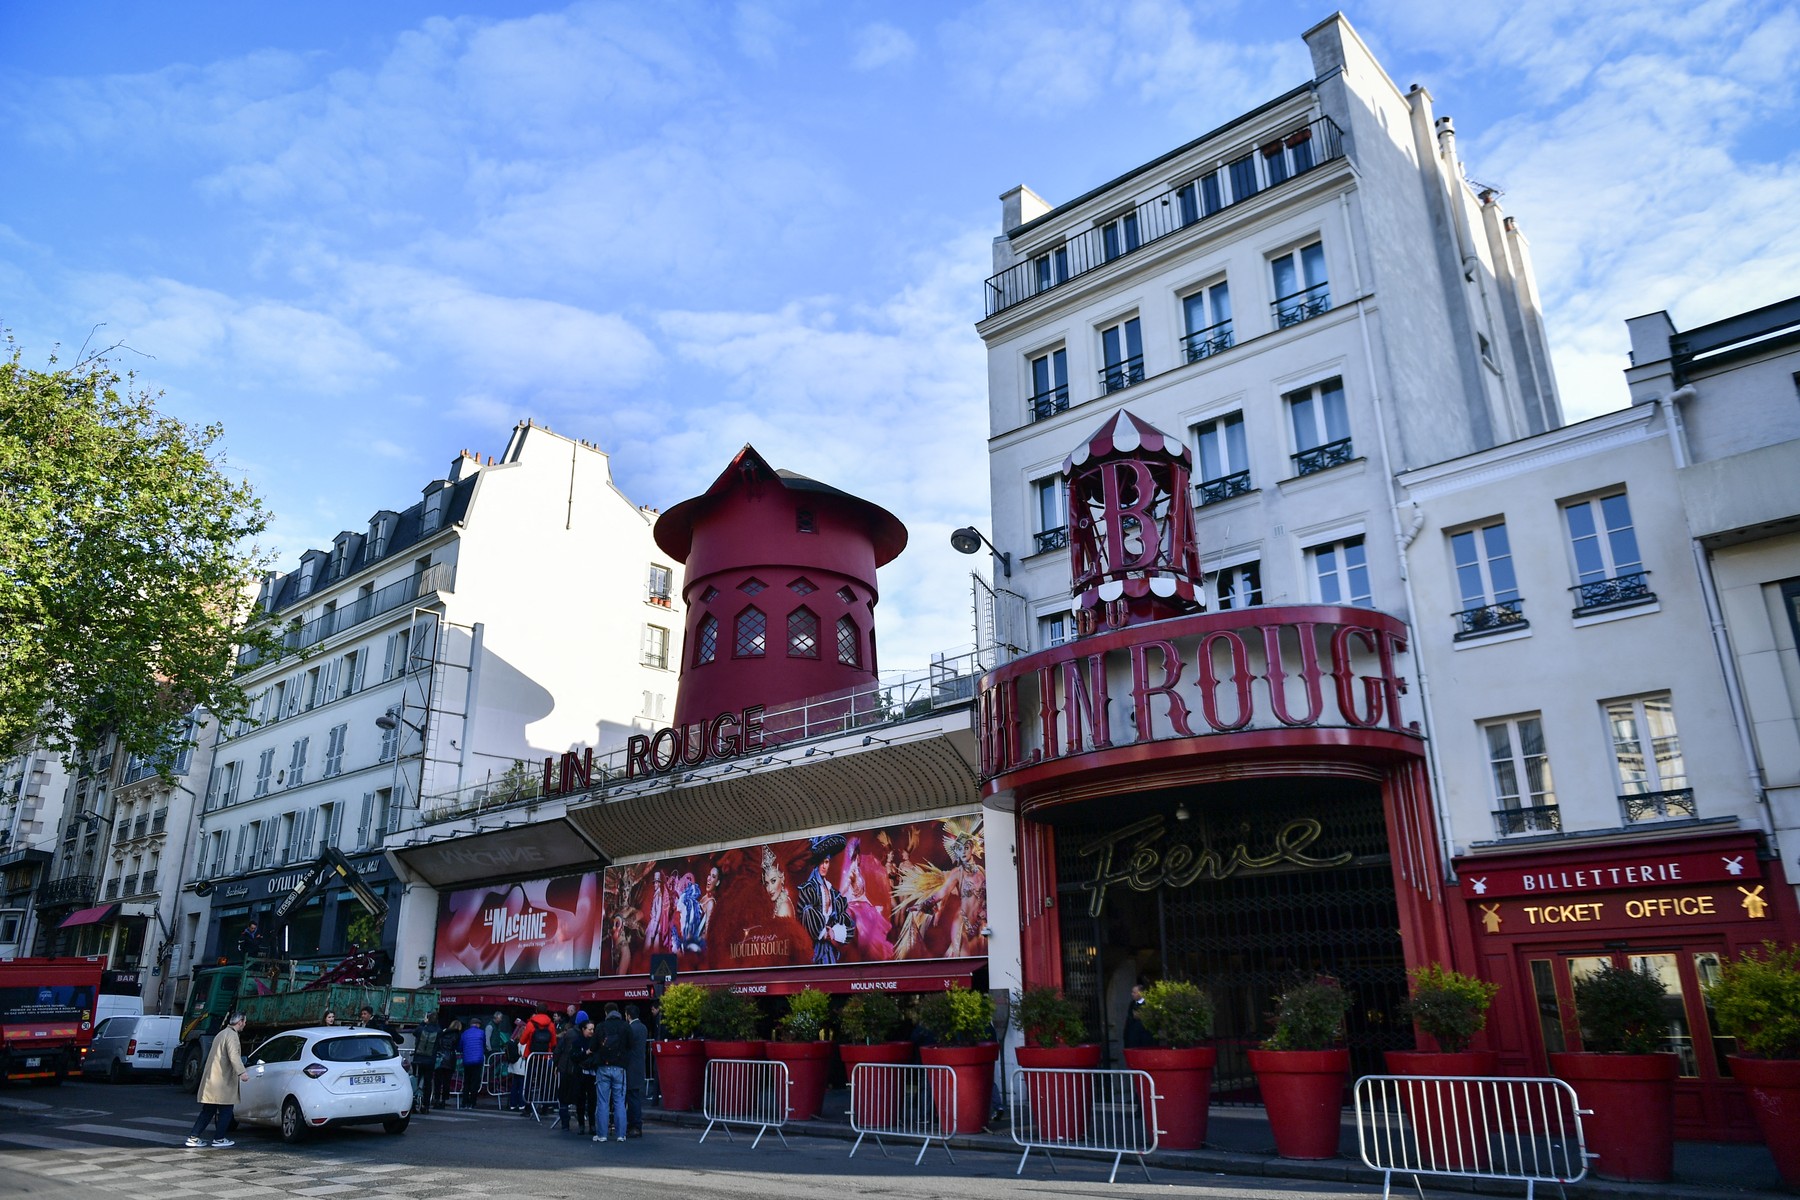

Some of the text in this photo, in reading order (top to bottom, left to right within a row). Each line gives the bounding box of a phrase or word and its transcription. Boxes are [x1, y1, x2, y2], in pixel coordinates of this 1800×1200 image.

[1076, 598, 1130, 636] DU
[1127, 622, 1422, 742] ROUGE
[543, 704, 767, 797] LIN ROUGE
[1079, 814, 1353, 918] Féerie
[1522, 863, 1683, 891] BILLETTERIE
[277, 891, 298, 917] FASSI
[484, 909, 493, 922] LA
[1523, 895, 1717, 925] TICKET OFFICE
[730, 938, 790, 959] MOULIN ROUGE
[624, 990, 641, 998] MOULIN
[748, 985, 767, 993] ROUGE
[851, 981, 898, 990] MOULIN ROUGE
